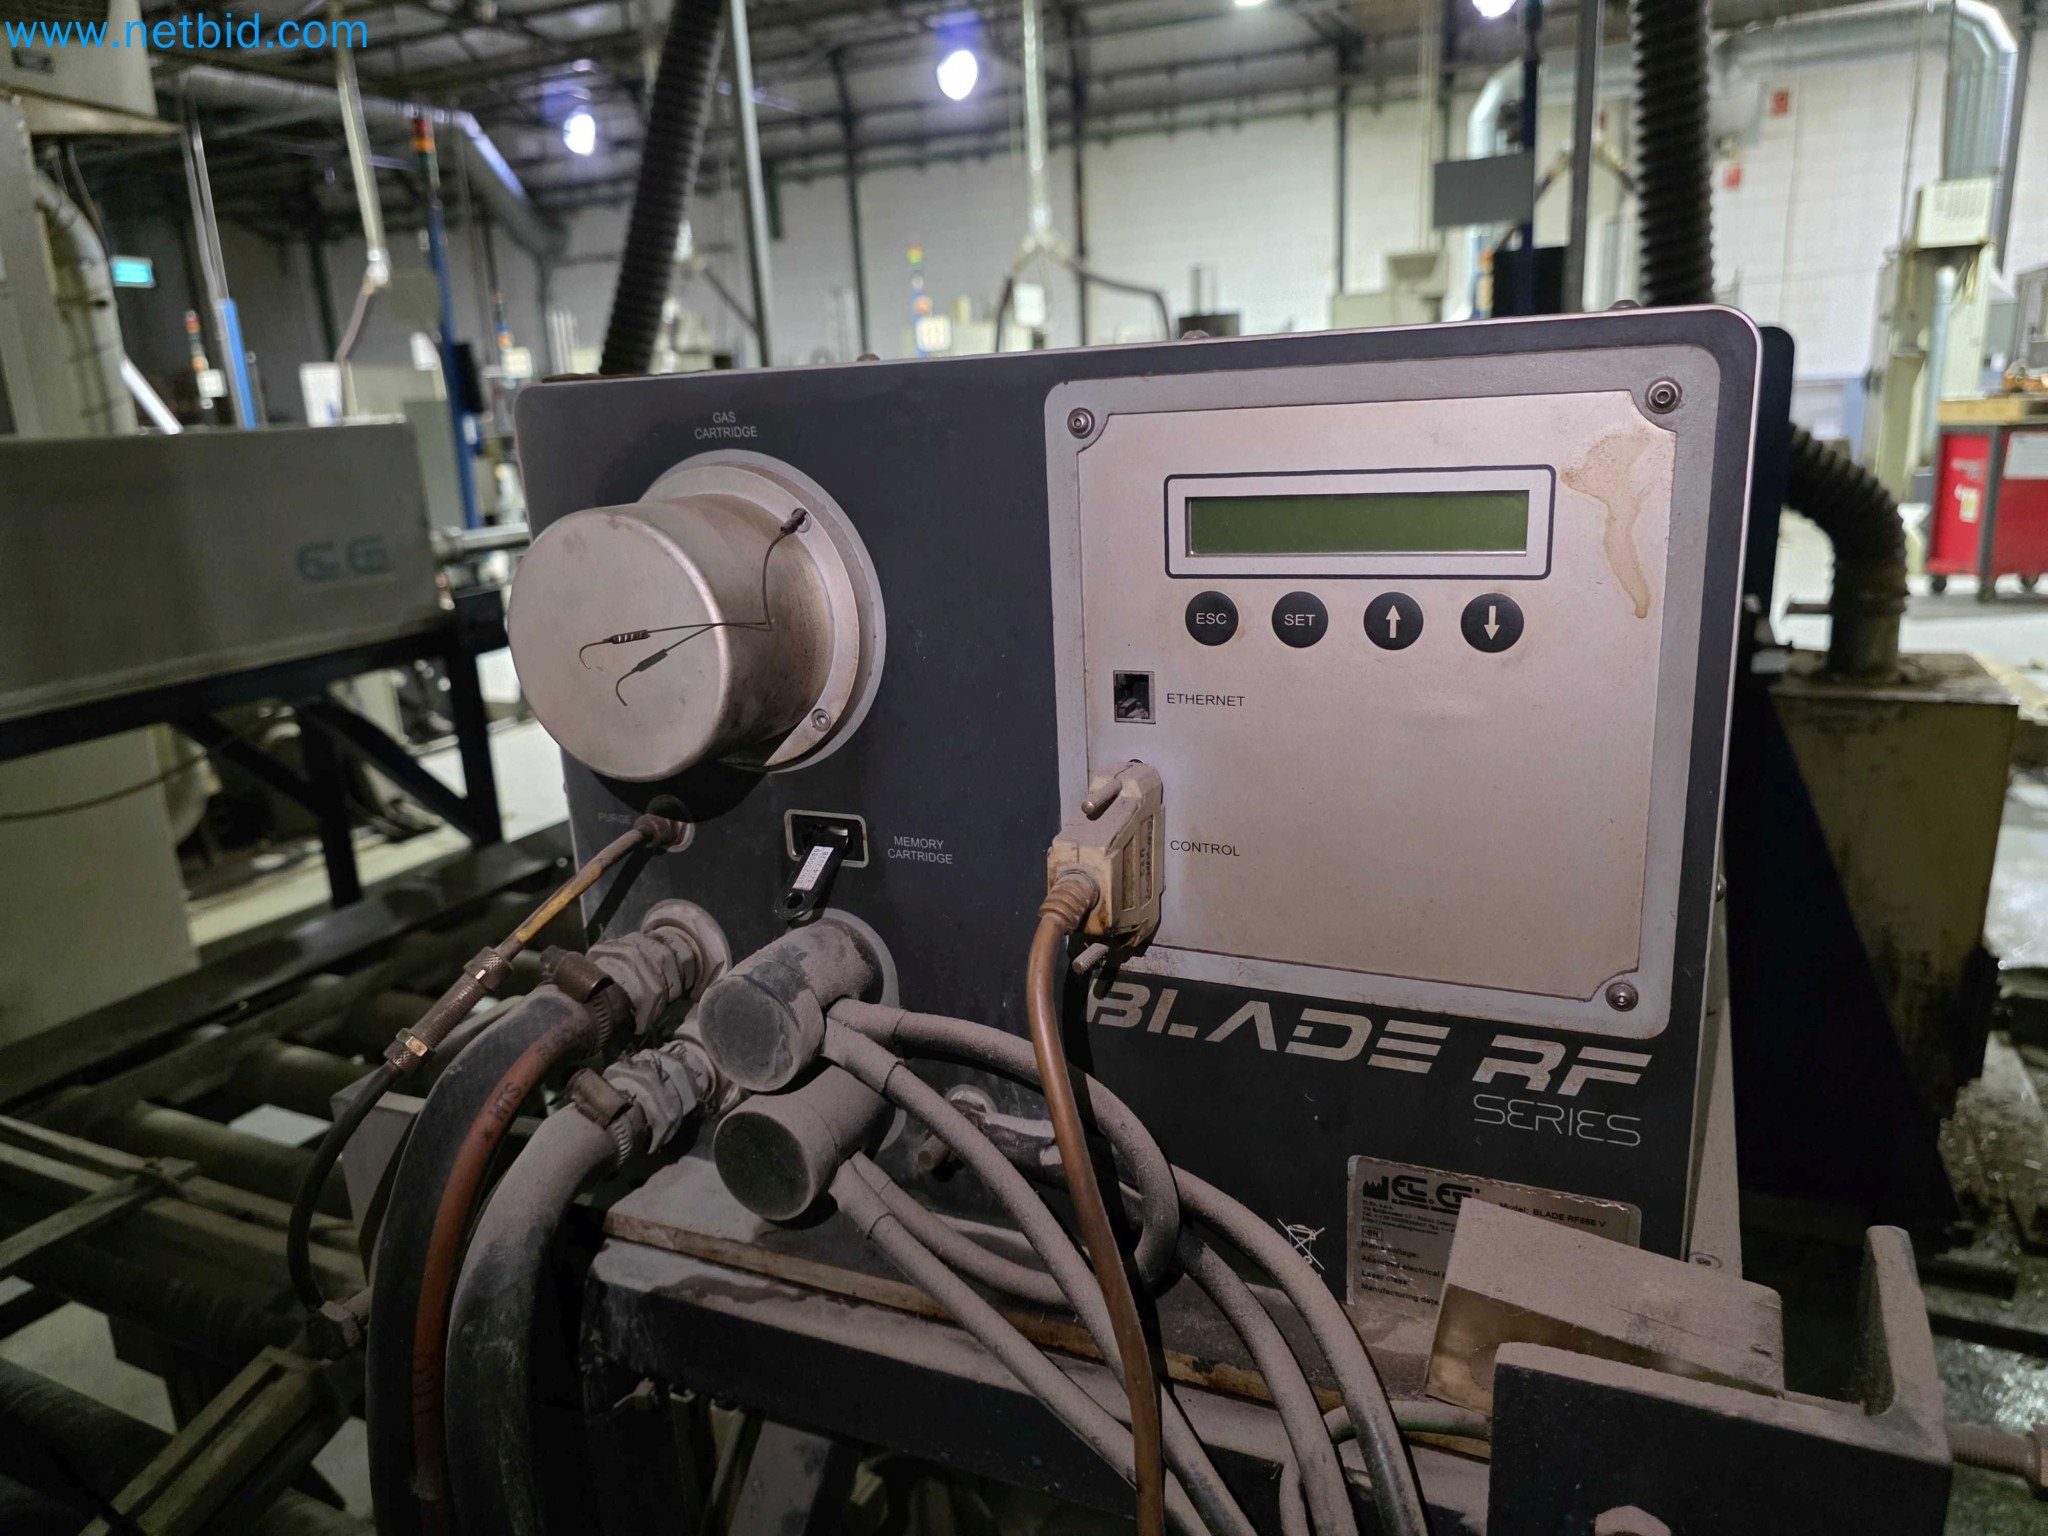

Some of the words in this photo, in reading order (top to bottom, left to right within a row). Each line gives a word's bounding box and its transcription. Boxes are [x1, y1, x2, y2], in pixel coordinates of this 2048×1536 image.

[712, 410, 737, 424] GAS
[694, 425, 759, 440] CARTRIDGE
[1196, 612, 1228, 625] ESC
[1284, 613, 1316, 627] SET
[1166, 692, 1246, 707] ETHERNET
[893, 835, 944, 850] MEMORY
[1170, 839, 1241, 857] CONTROL
[887, 847, 954, 865] CARTRIDGE
[1086, 978, 1451, 1075] BLADE
[1472, 1034, 1653, 1097] RF
[1473, 1093, 1641, 1147] SERIES
[1532, 1208, 1565, 1221] BLADE
[1361, 1269, 1384, 1280] Laser
[1402, 1264, 1440, 1277] electrical
[1361, 1282, 1419, 1303] Manufacturing
